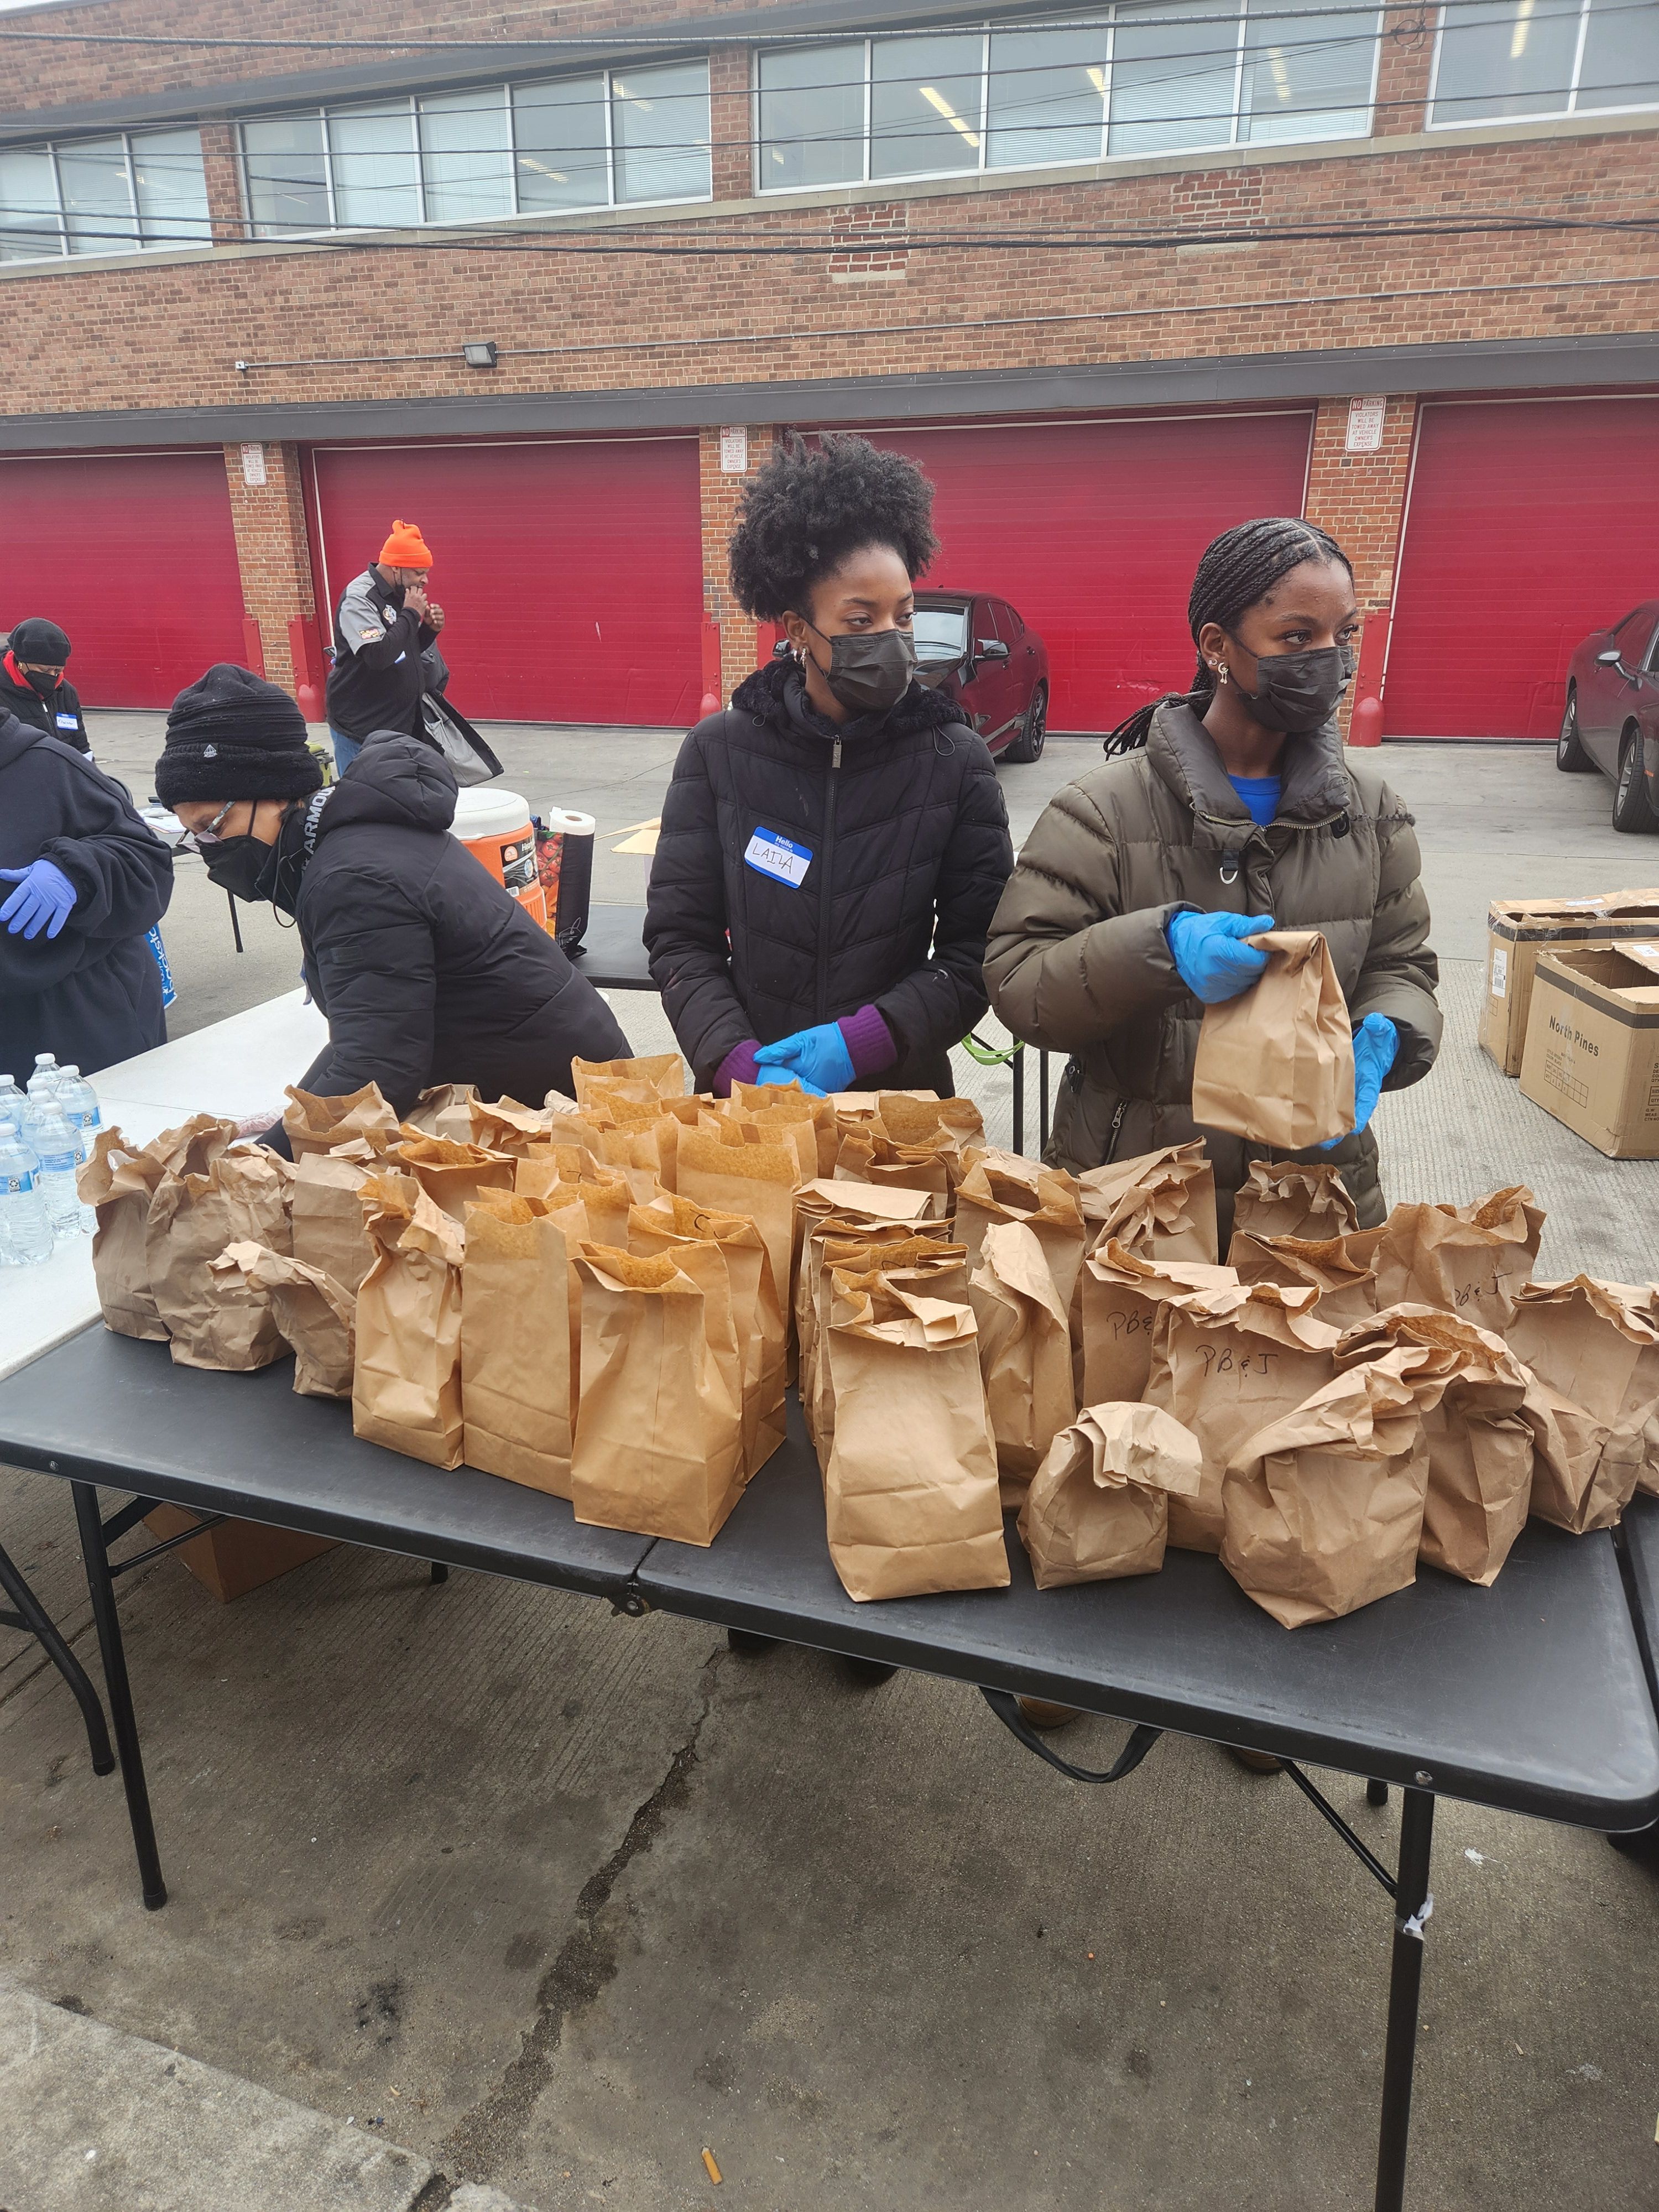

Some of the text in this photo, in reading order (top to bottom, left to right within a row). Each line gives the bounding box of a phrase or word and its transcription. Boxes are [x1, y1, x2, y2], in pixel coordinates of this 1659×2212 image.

[1352, 400, 1361, 409] NO
[775, 836, 793, 848] Hello
[752, 842, 794, 874] LAILA
[1549, 1015, 1599, 1057] North Pines
